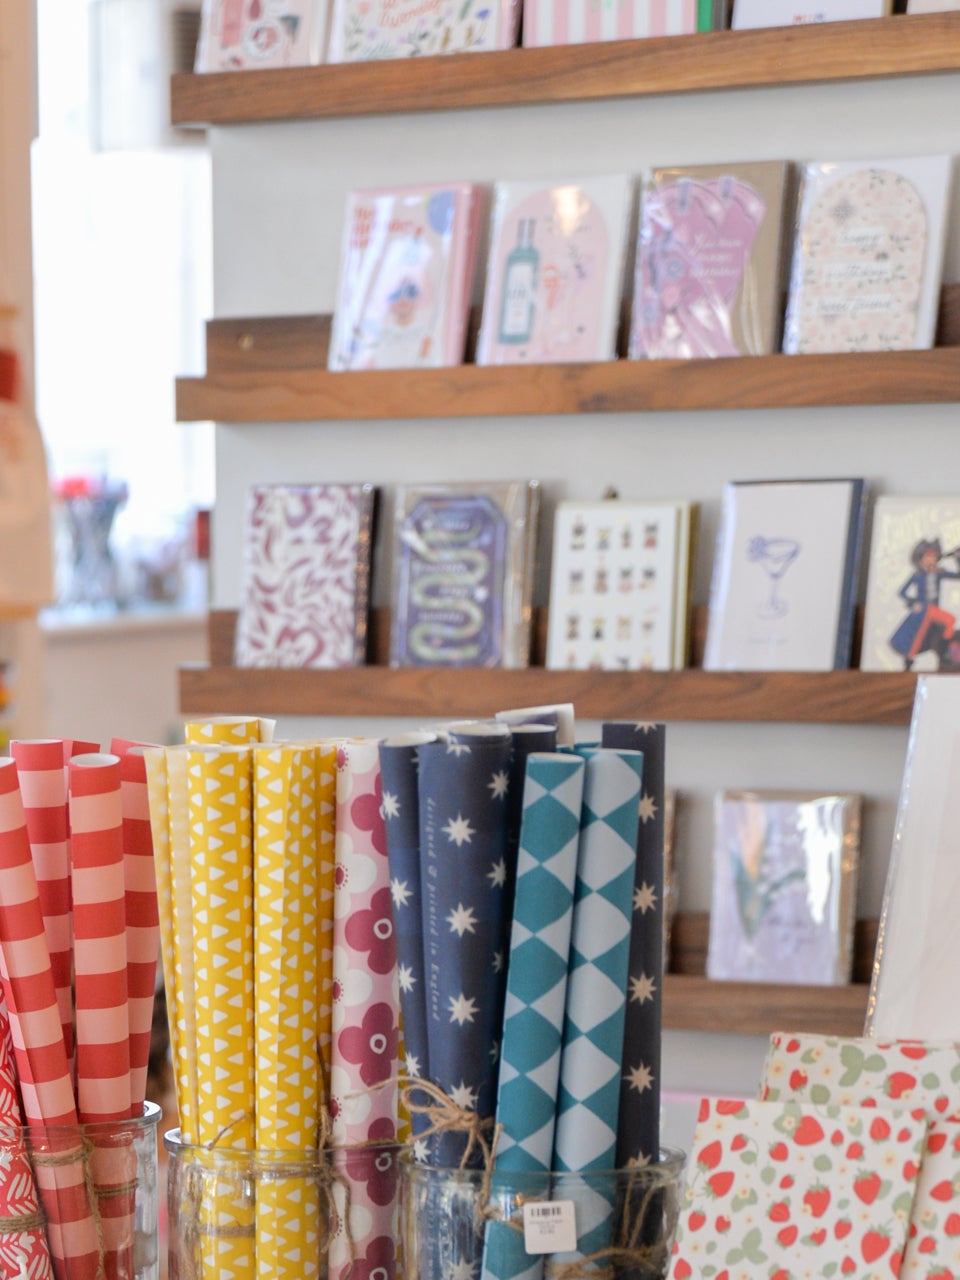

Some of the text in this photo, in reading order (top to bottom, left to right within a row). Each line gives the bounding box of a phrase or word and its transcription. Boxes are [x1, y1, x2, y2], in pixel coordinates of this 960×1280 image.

[425, 797, 436, 858] designed
[426, 883, 439, 936] printed
[429, 963, 441, 1020] England
